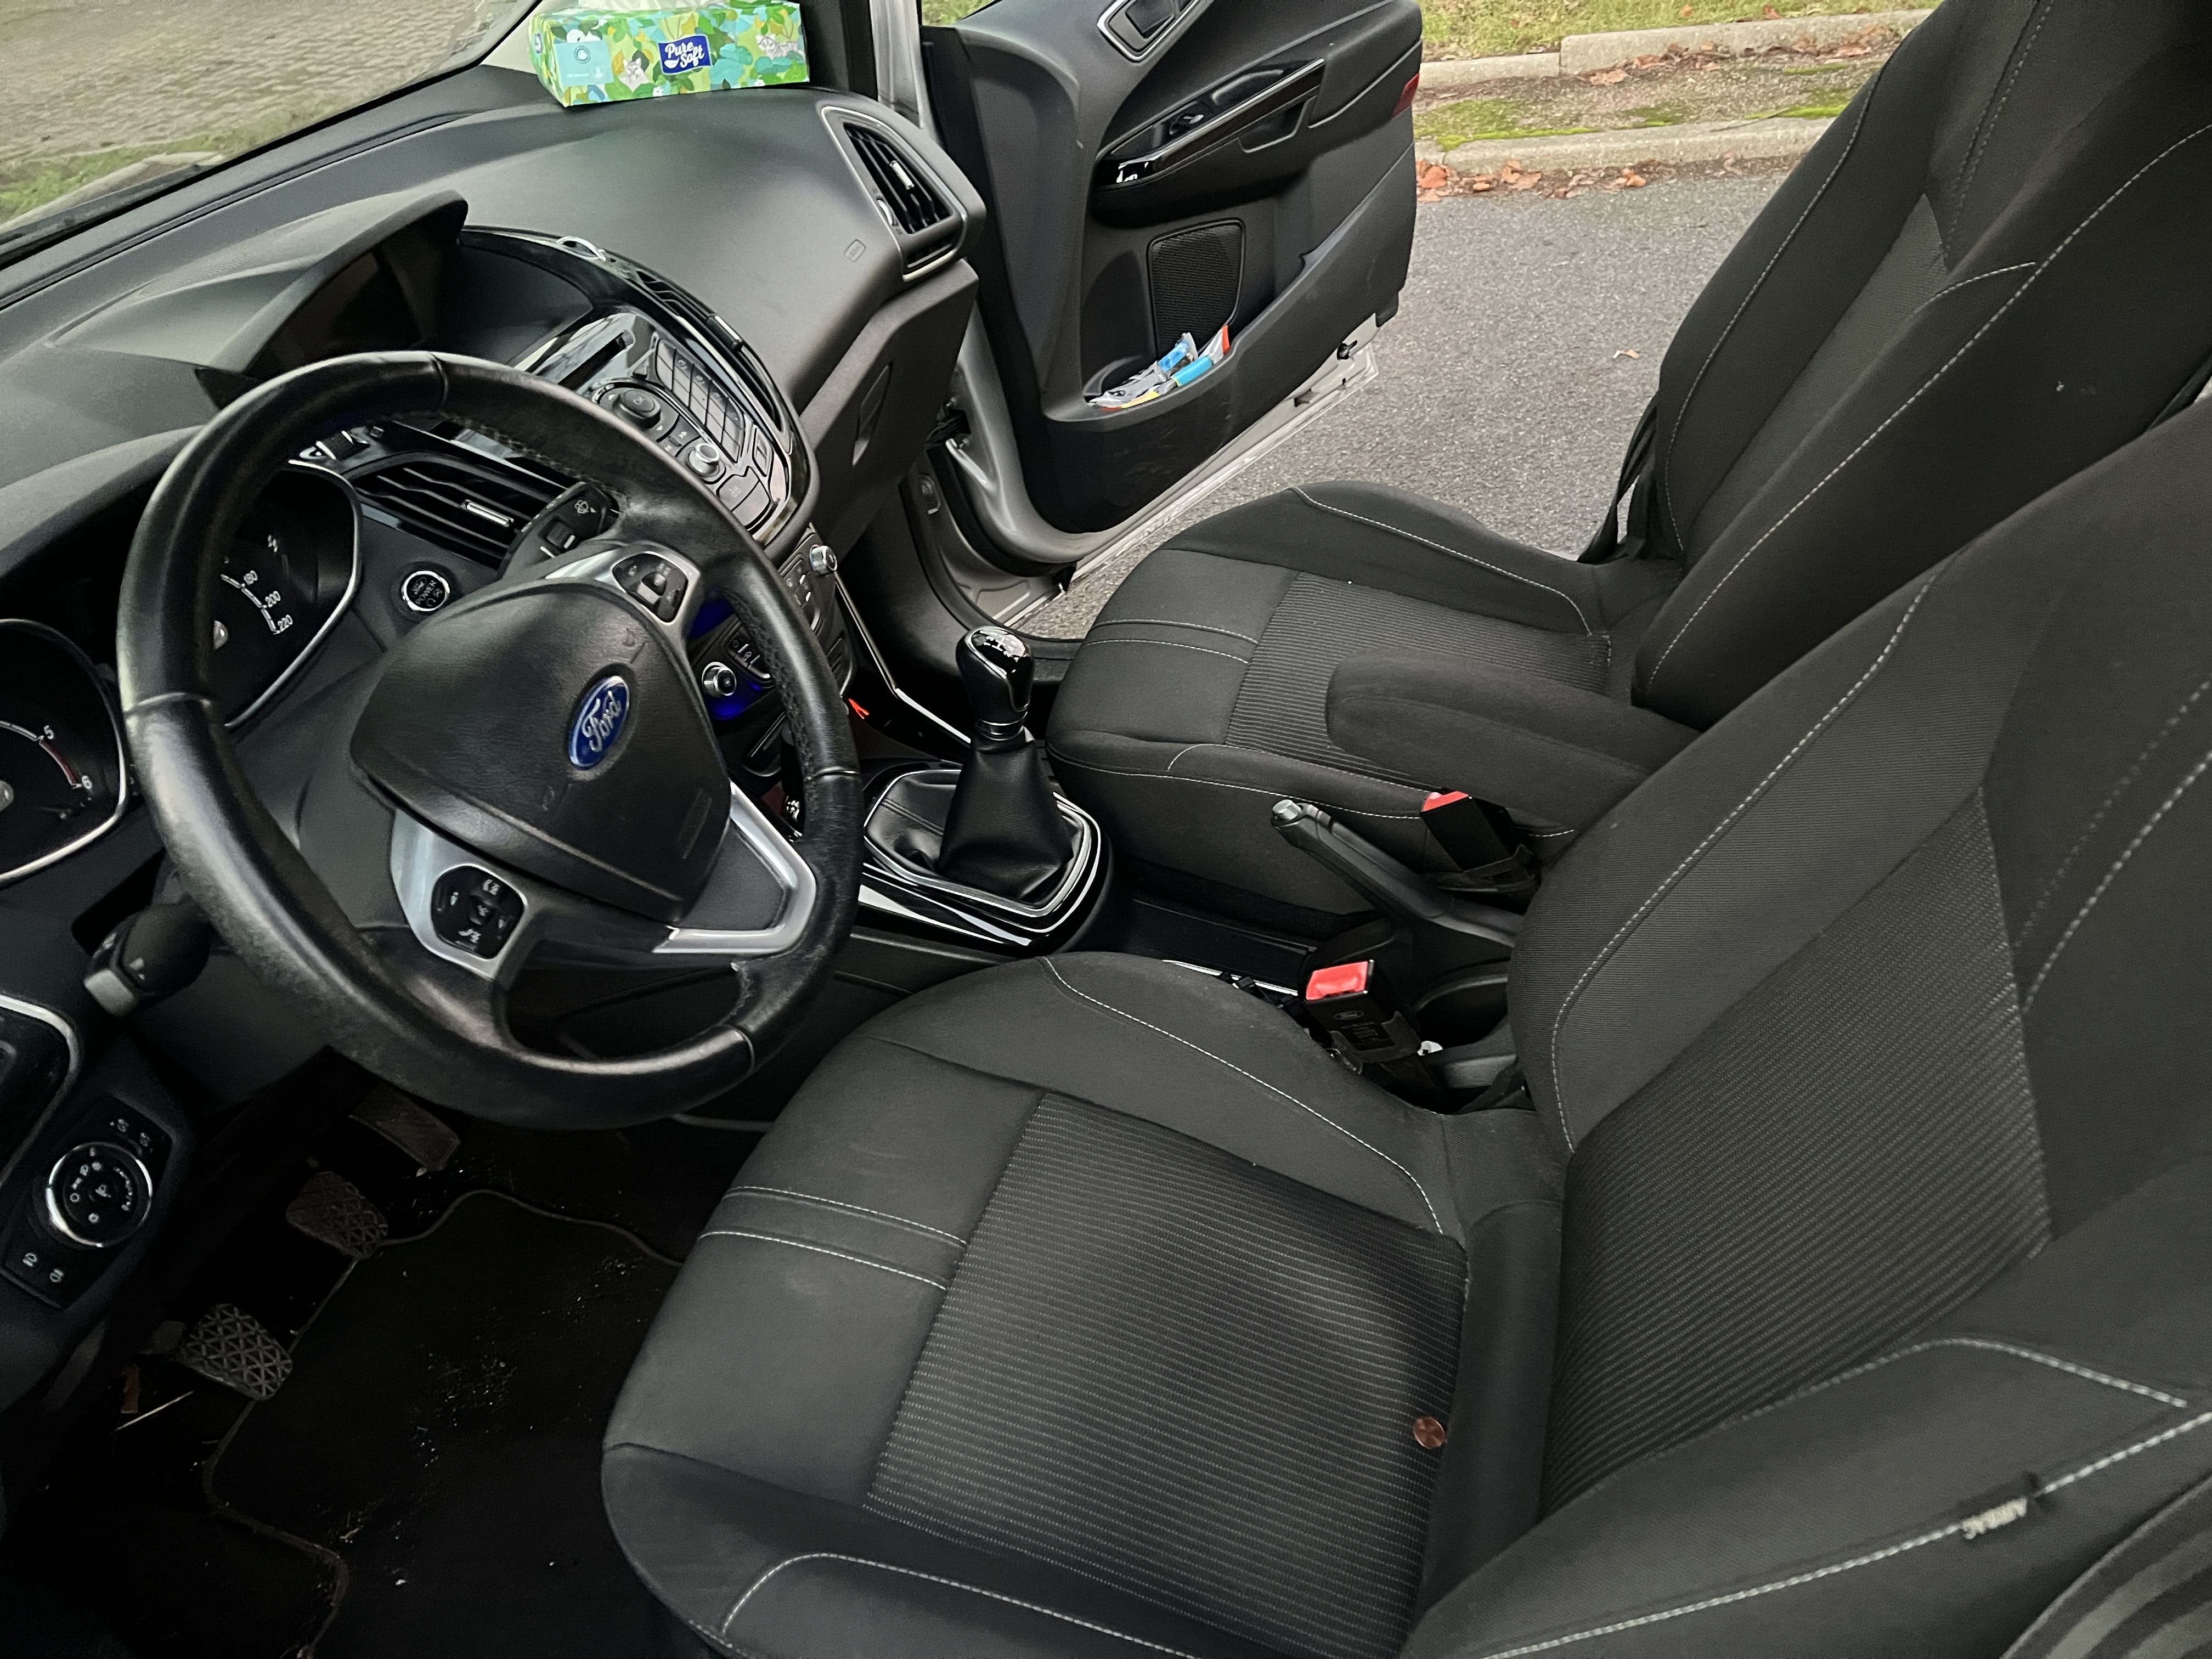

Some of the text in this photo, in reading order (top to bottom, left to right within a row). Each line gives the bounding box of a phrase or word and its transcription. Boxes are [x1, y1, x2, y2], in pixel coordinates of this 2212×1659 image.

[665, 42, 695, 59] Pure
[680, 45, 705, 68] Soft
[265, 591, 281, 607] 200
[415, 580, 437, 605] POWER
[277, 614, 293, 631] 220
[582, 690, 622, 752] Ford
[44, 725, 54, 739] 5
[82, 775, 92, 789] 6
